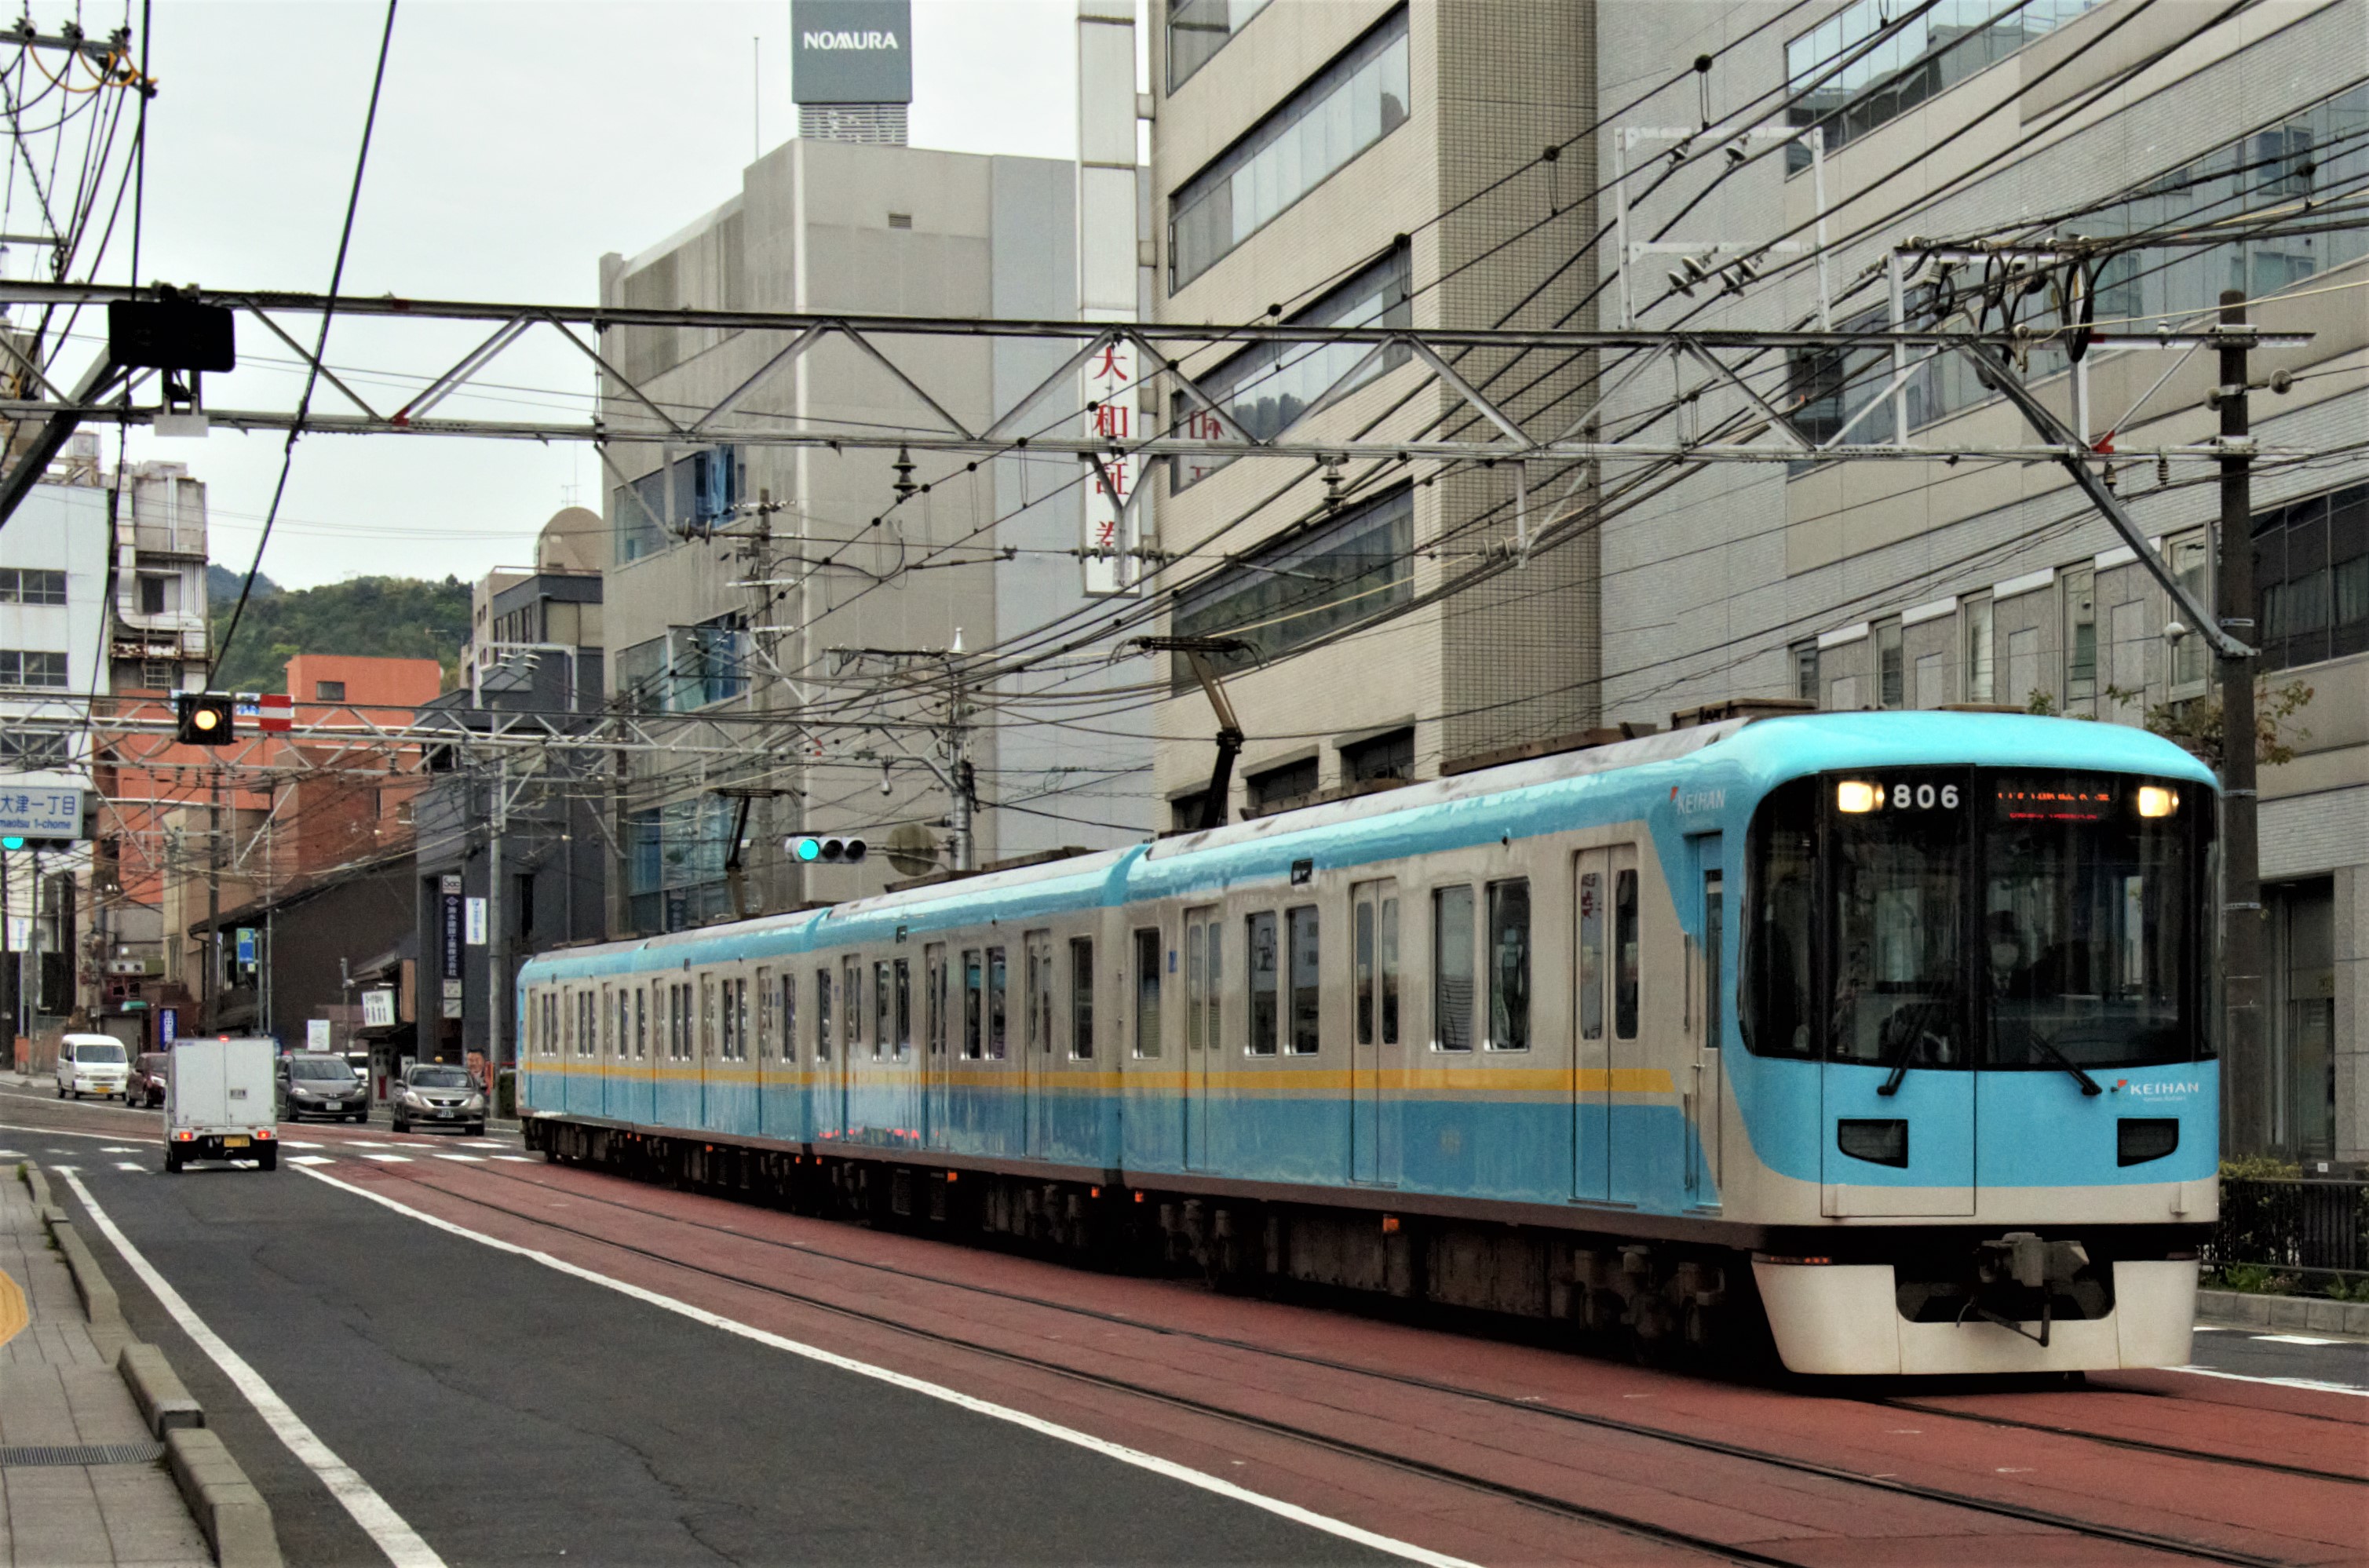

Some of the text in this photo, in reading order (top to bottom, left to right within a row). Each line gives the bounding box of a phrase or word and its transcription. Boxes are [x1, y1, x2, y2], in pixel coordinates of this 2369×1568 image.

[804, 31, 899, 49] NOMURA
[0, 795, 75, 815] 大津一丁目
[1677, 788, 1726, 815] KEIHAN
[1893, 784, 1959, 808] 806
[35, 819, 71, 830] 1-chome
[2130, 1082, 2199, 1095] KEIHAN
